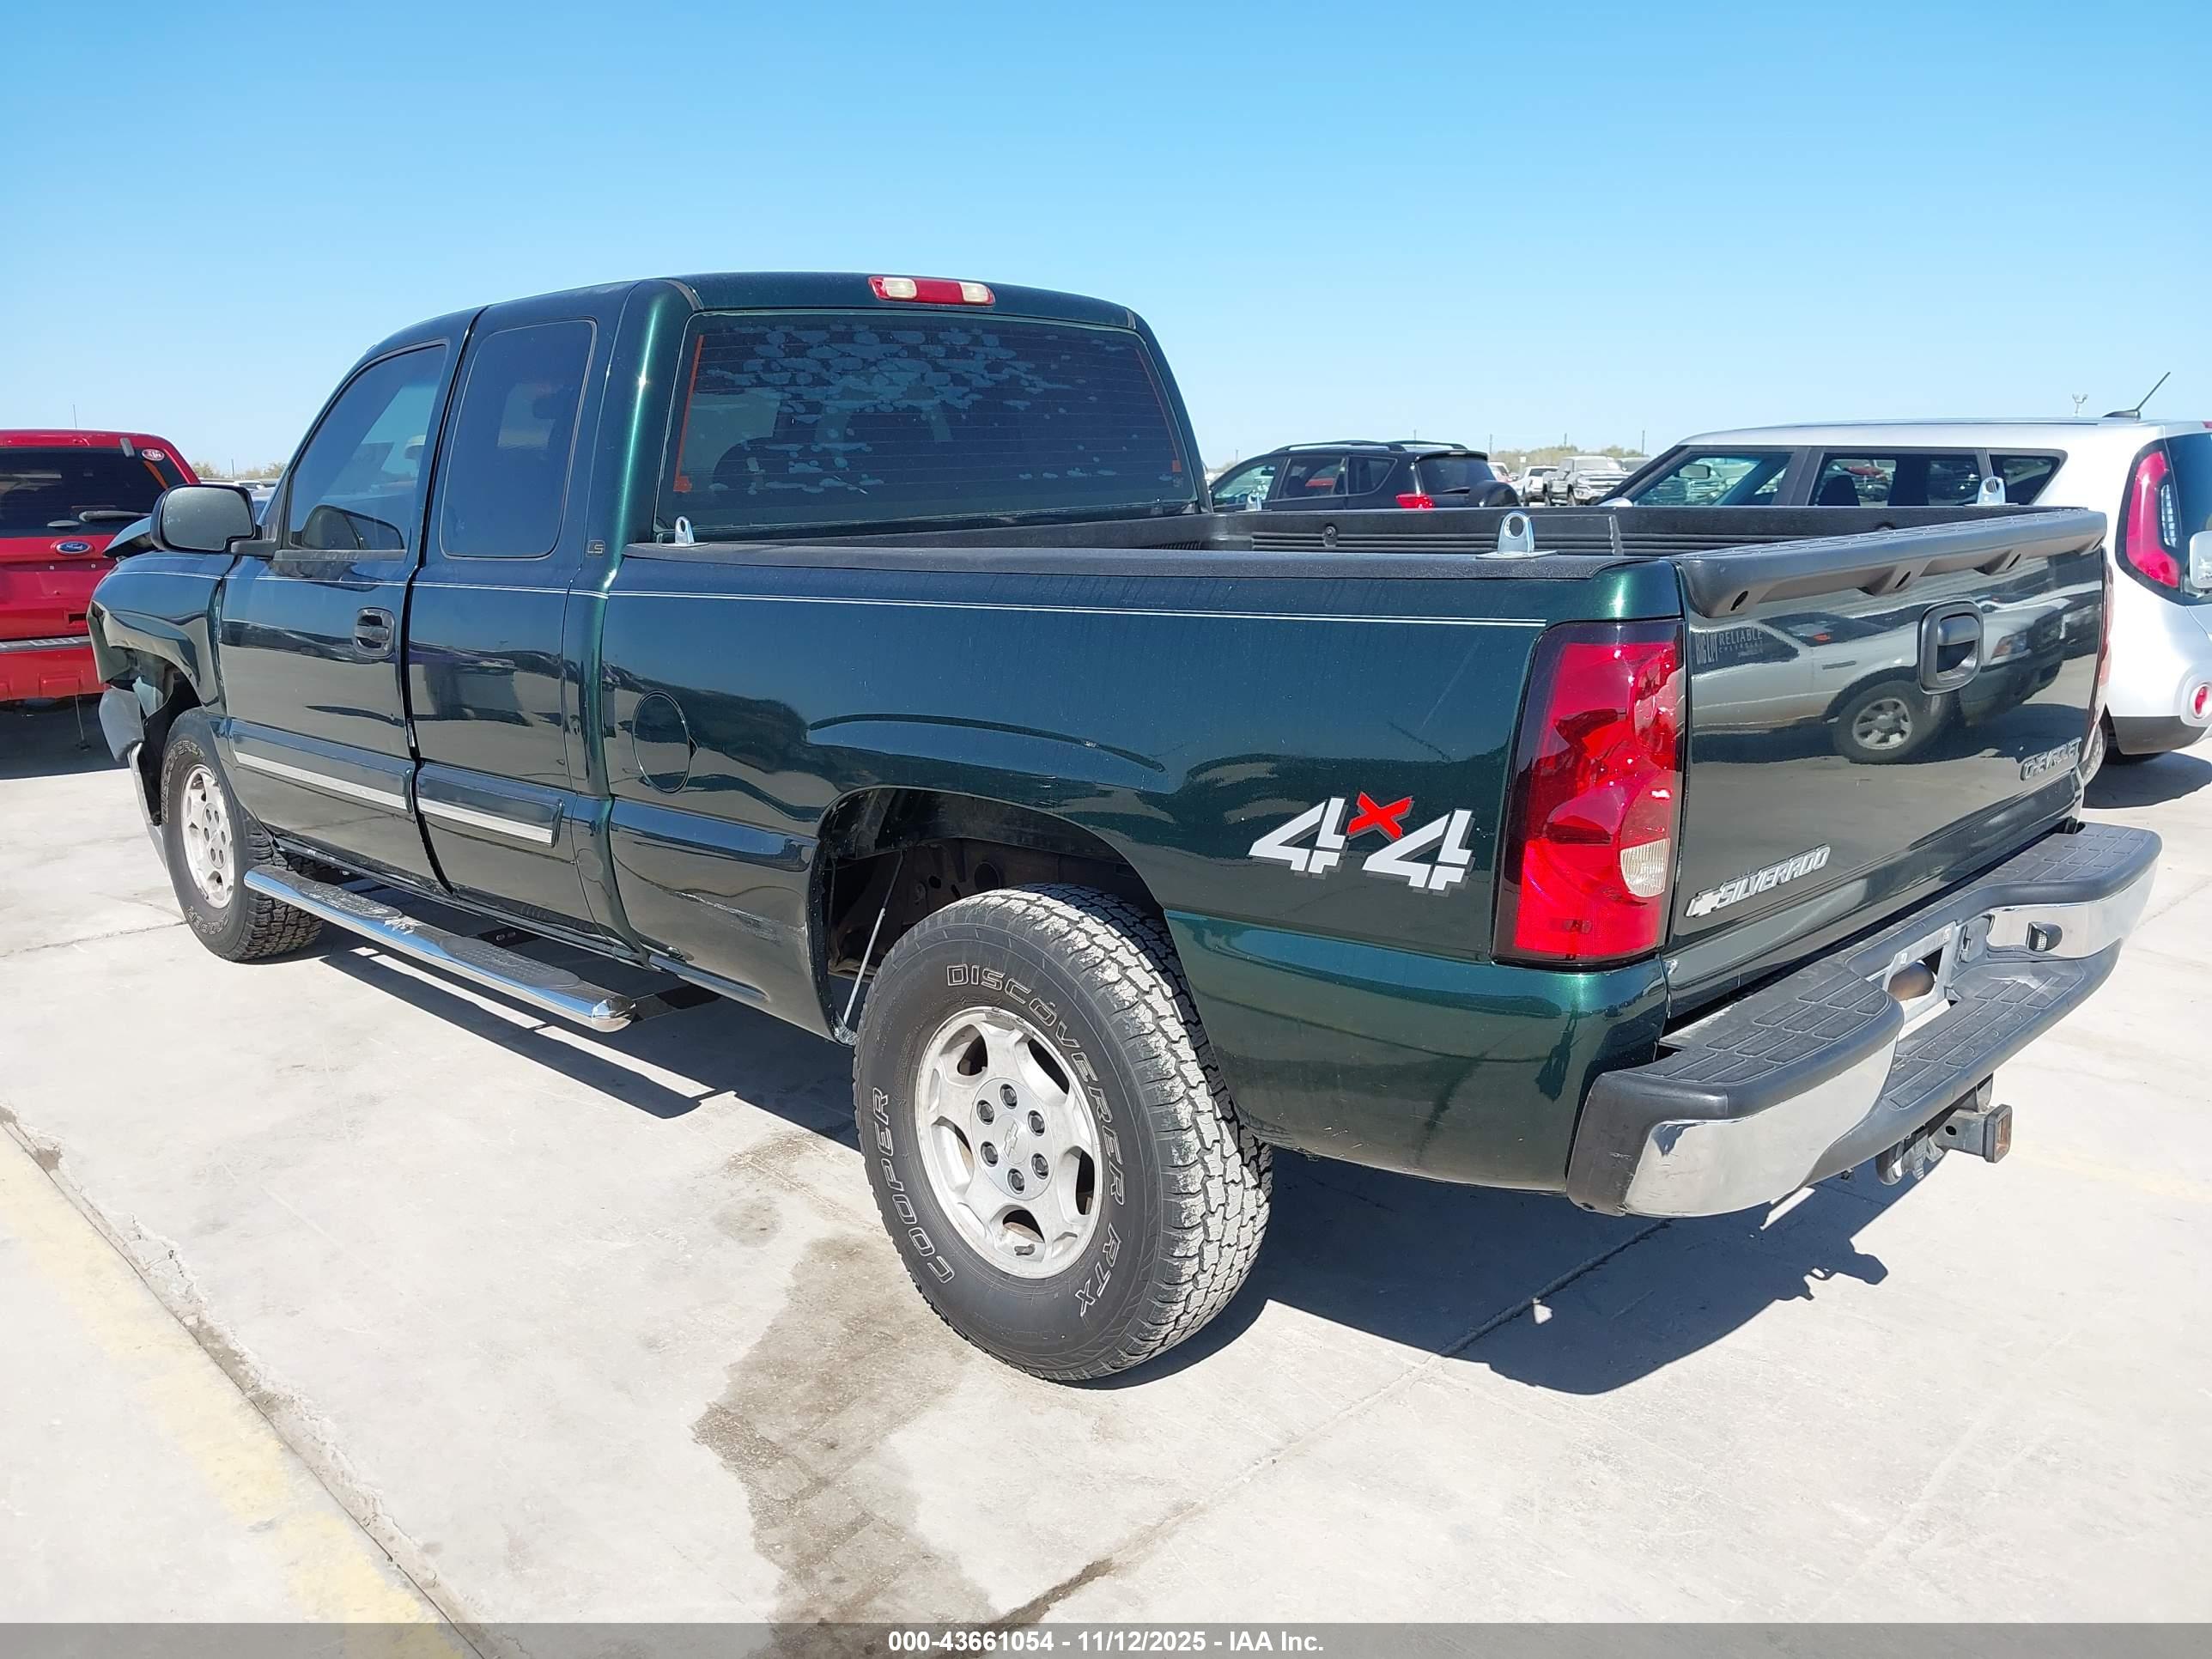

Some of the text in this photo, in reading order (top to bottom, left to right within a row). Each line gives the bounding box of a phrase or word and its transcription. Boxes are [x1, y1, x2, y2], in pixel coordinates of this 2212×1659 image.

[586, 544, 605, 554] LS
[1718, 627, 1764, 646] RELIABLE
[1717, 844, 1831, 908] SILVERADO
[945, 962, 1126, 1320] DISCOVERER RTX
[871, 1086, 956, 1285] COOPER
